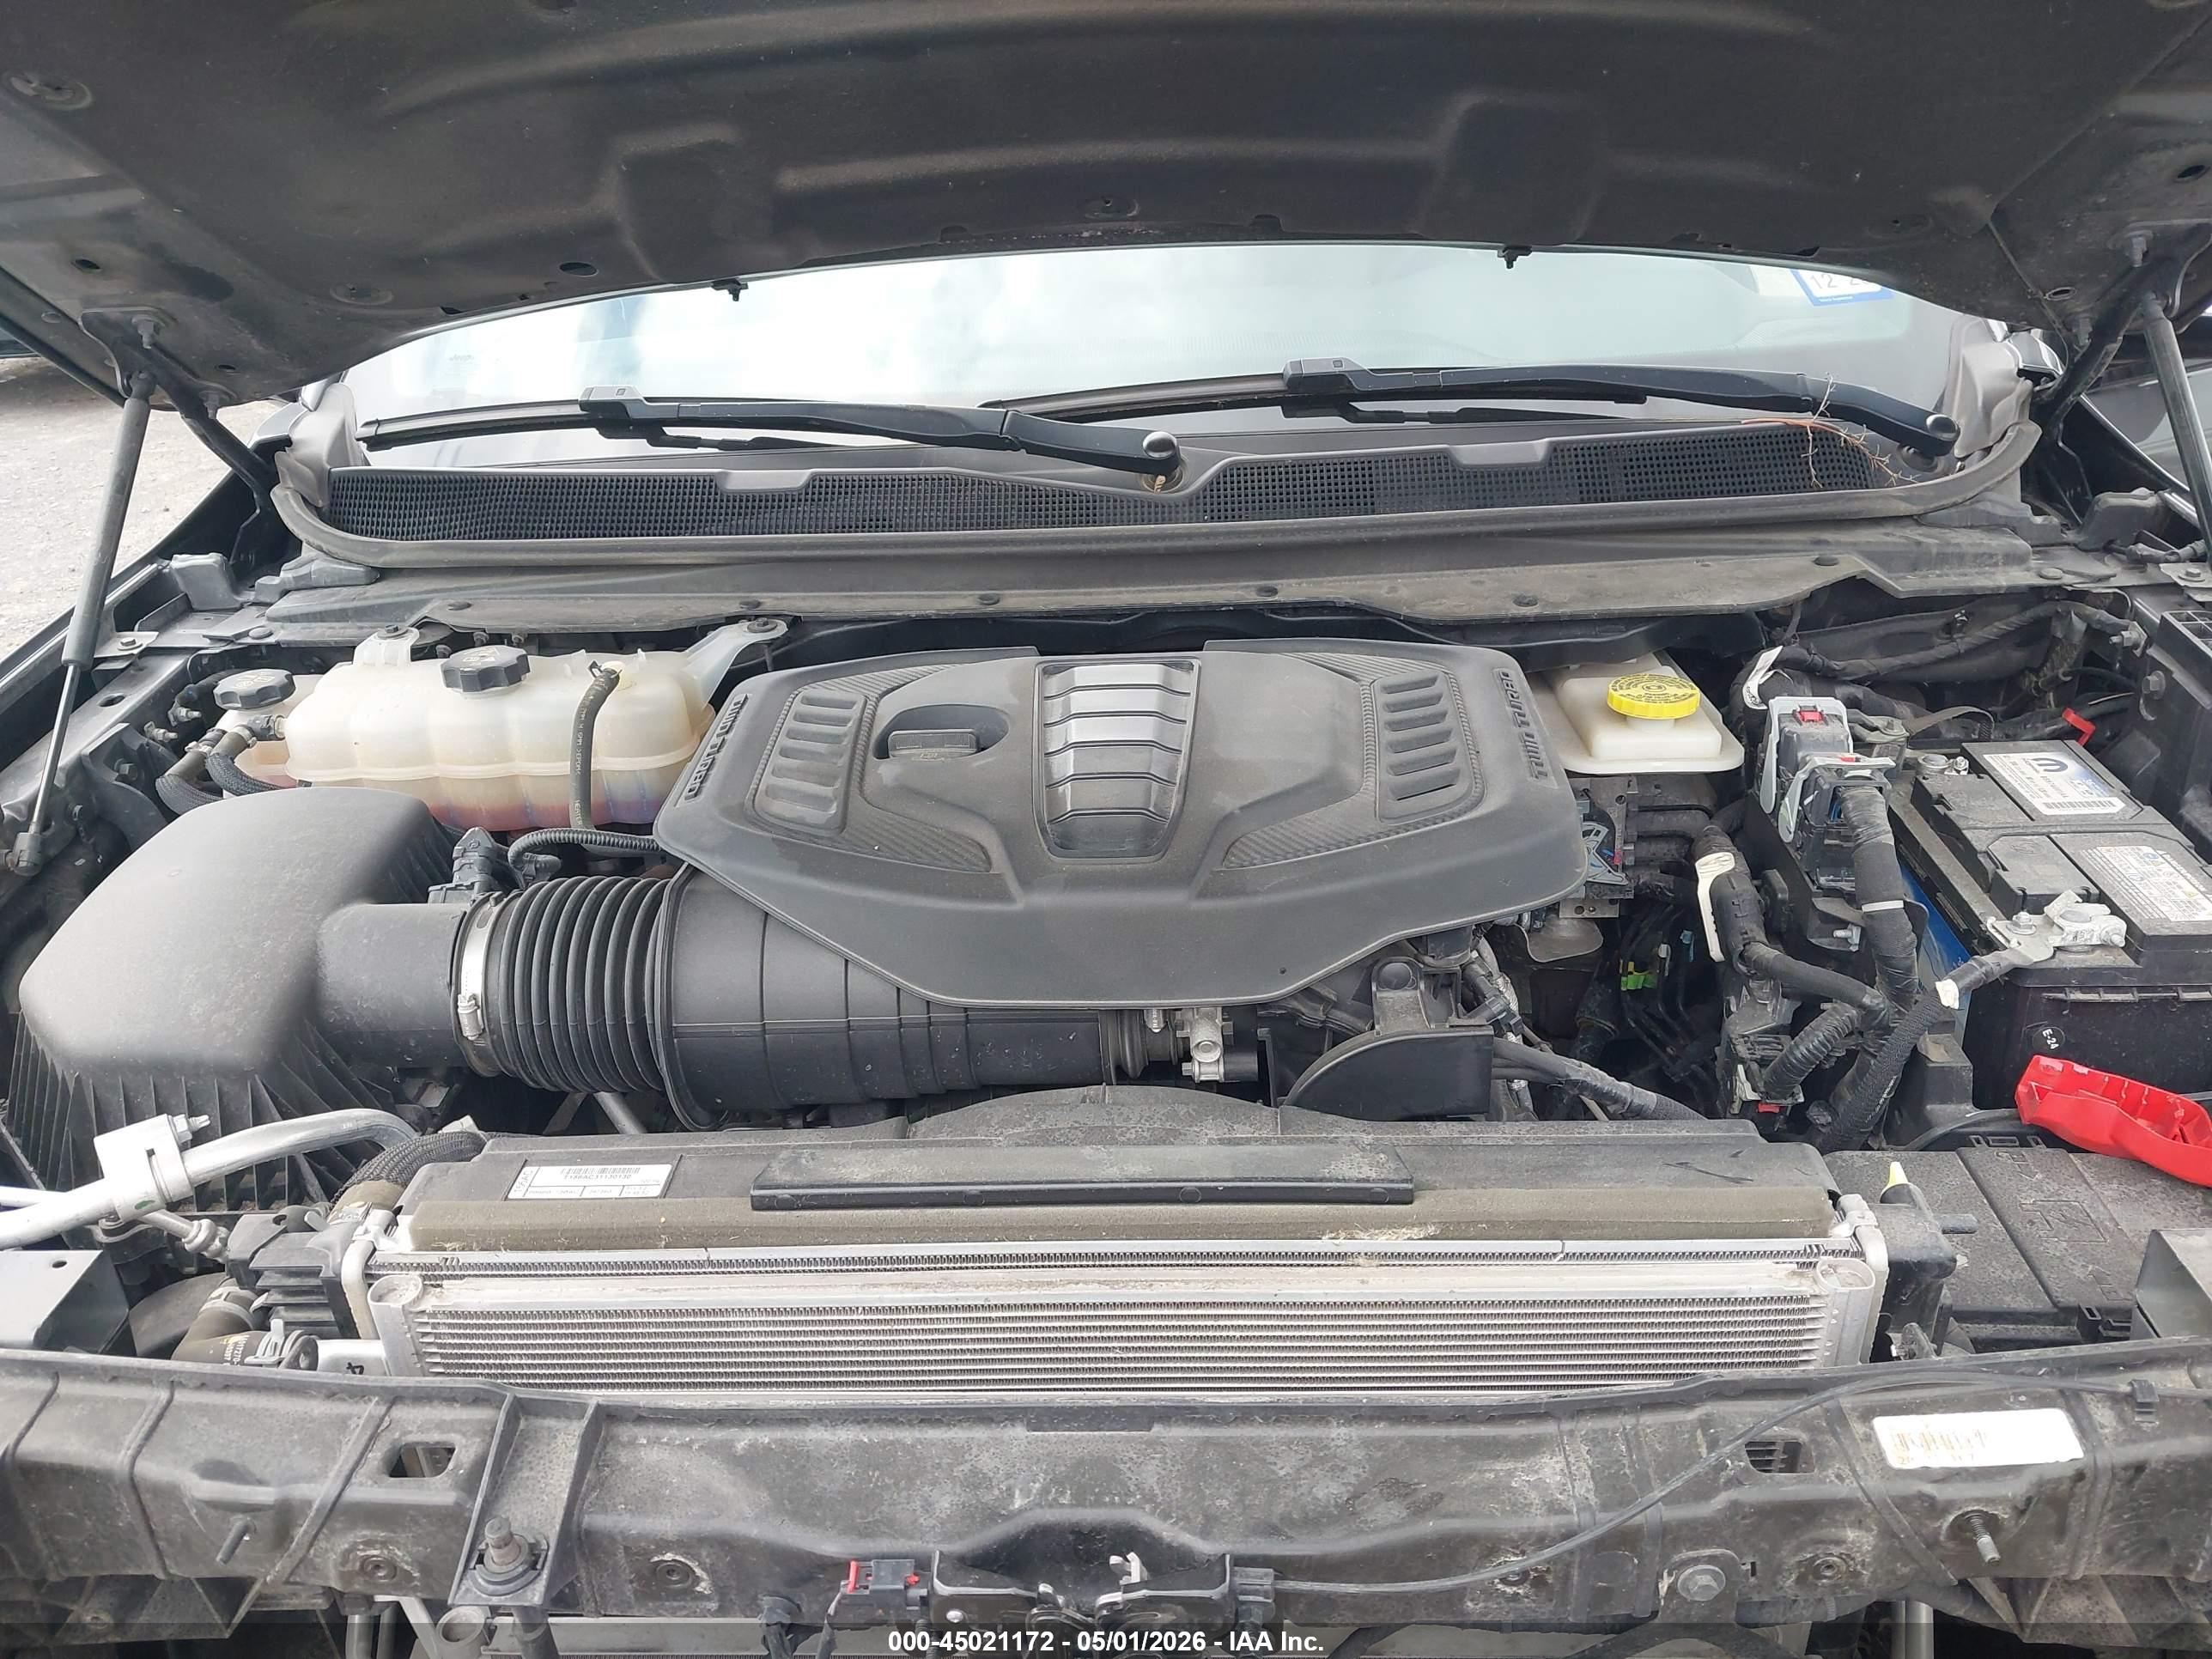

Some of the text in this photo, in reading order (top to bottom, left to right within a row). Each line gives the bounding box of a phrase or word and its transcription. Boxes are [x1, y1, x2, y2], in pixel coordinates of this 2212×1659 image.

[1809, 273, 1838, 289] 12
[684, 694, 750, 801] TWIN TURBO
[1498, 671, 1548, 780] TWIN TURBO
